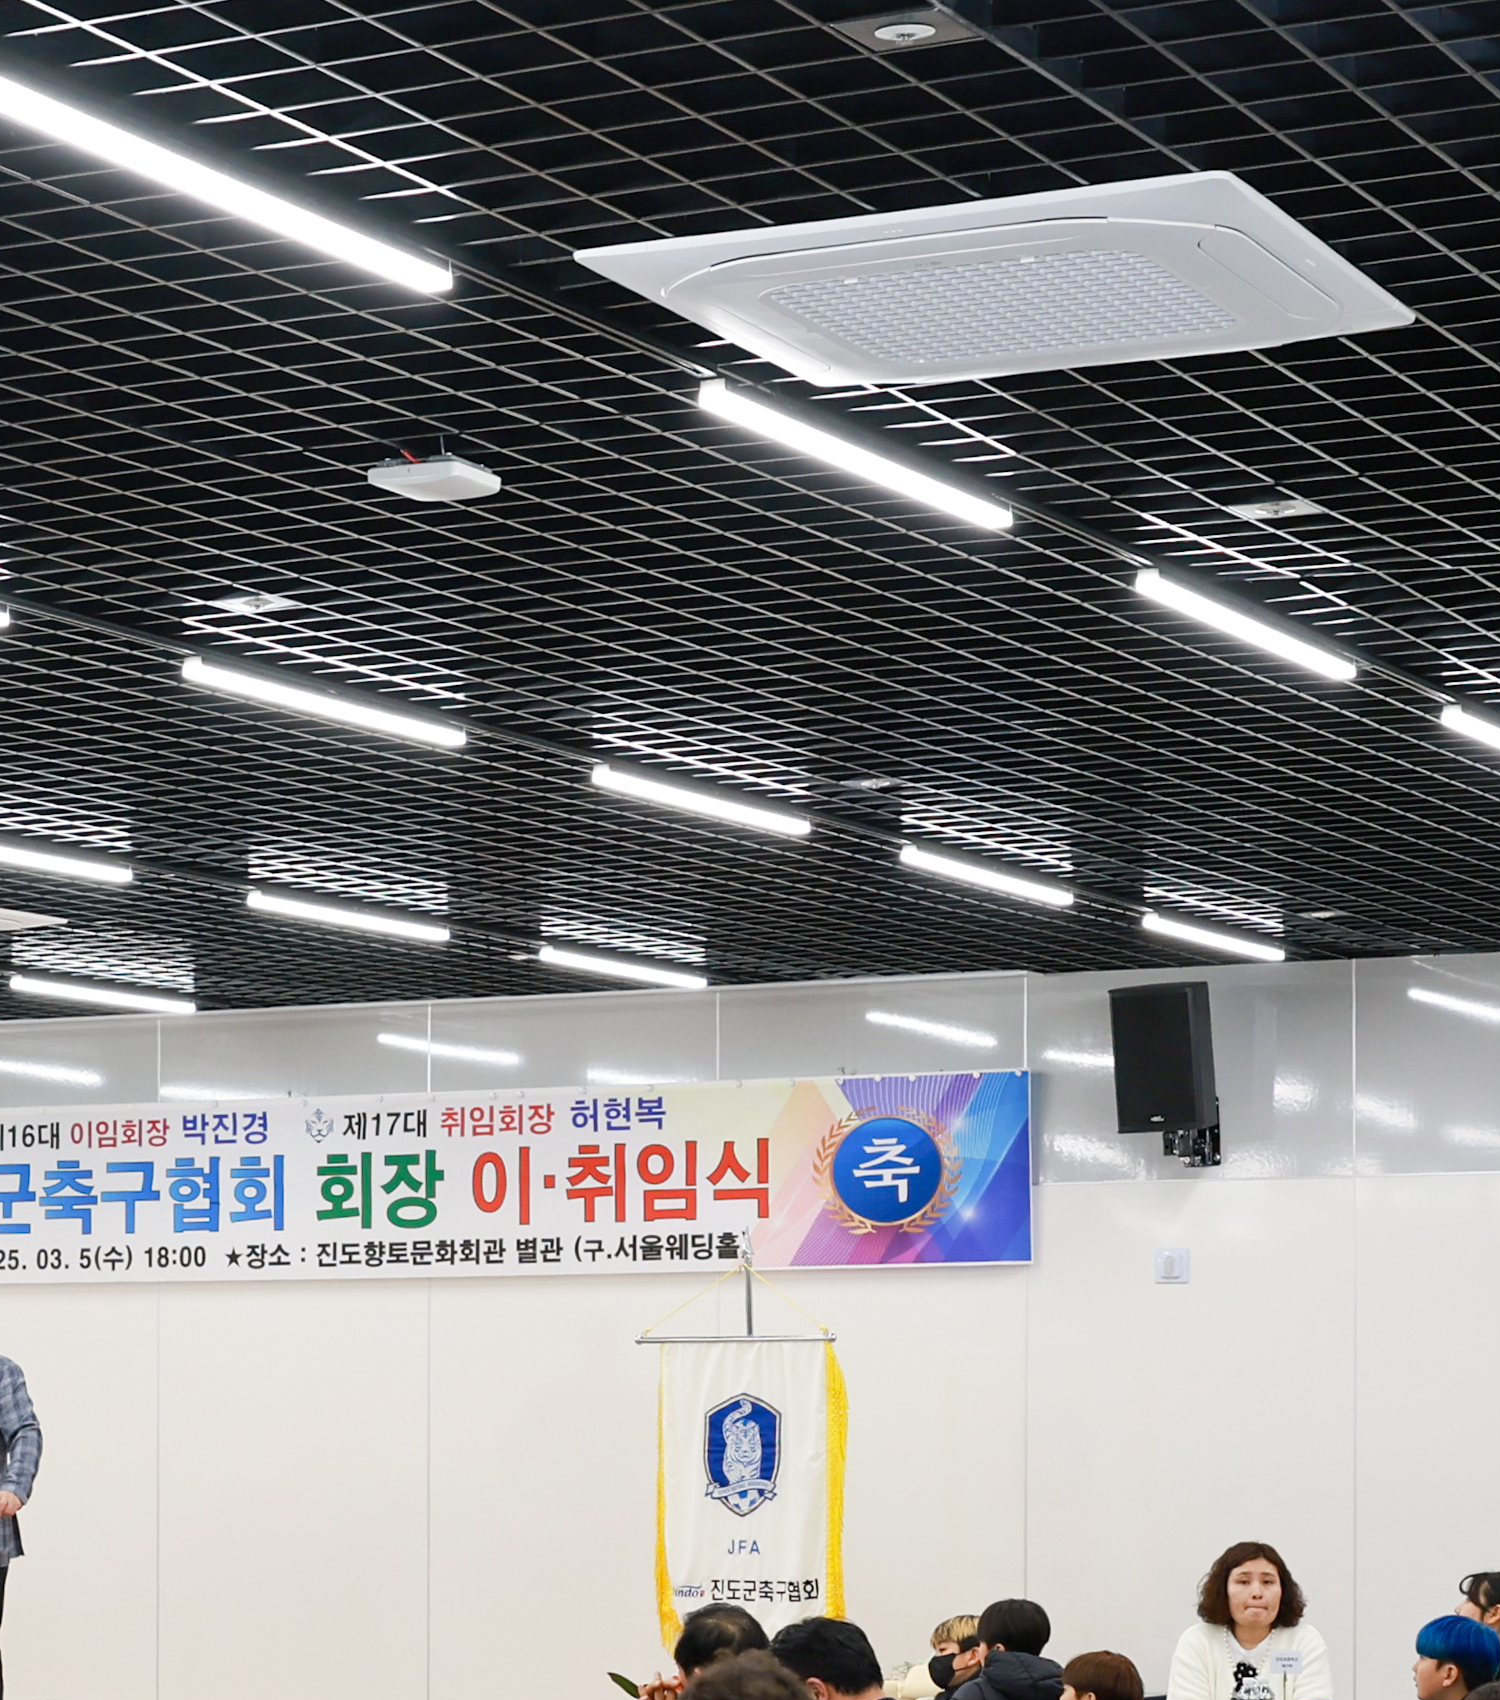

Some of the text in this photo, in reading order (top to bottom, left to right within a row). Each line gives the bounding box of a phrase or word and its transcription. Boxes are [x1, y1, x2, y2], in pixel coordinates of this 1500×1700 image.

[70, 1118, 170, 1148] 이임회장
[181, 1110, 269, 1145] 박진경
[342, 1096, 667, 1141] 제17대 취임회장 허현복
[853, 1136, 920, 1203] 축
[315, 1149, 445, 1229] 회장
[144, 1245, 207, 1268] 18:00
[315, 1238, 506, 1268] 진도향토문화회관
[515, 1236, 564, 1263] 별관
[727, 1539, 761, 1555] JFA
[710, 1578, 820, 1602] 진도군축구협회
